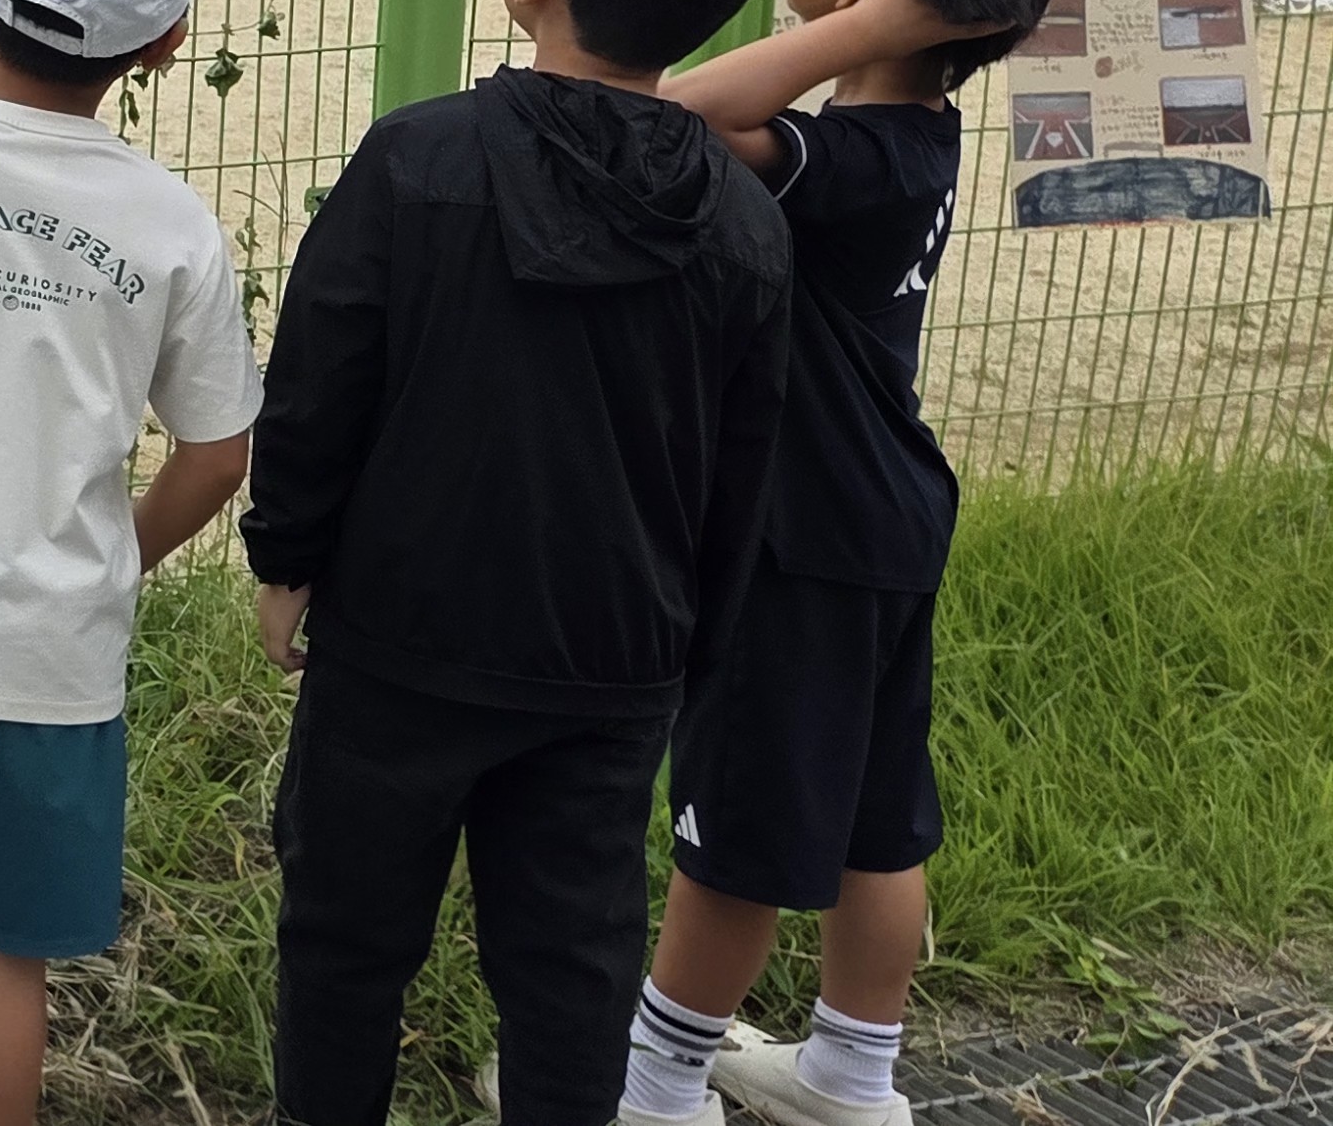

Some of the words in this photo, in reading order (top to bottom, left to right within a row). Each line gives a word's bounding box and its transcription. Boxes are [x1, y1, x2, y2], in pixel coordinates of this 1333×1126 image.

[62, 226, 145, 304] FEAR
[10, 286, 70, 306] GEOGRAPHIC
[20, 301, 42, 312] 1888
